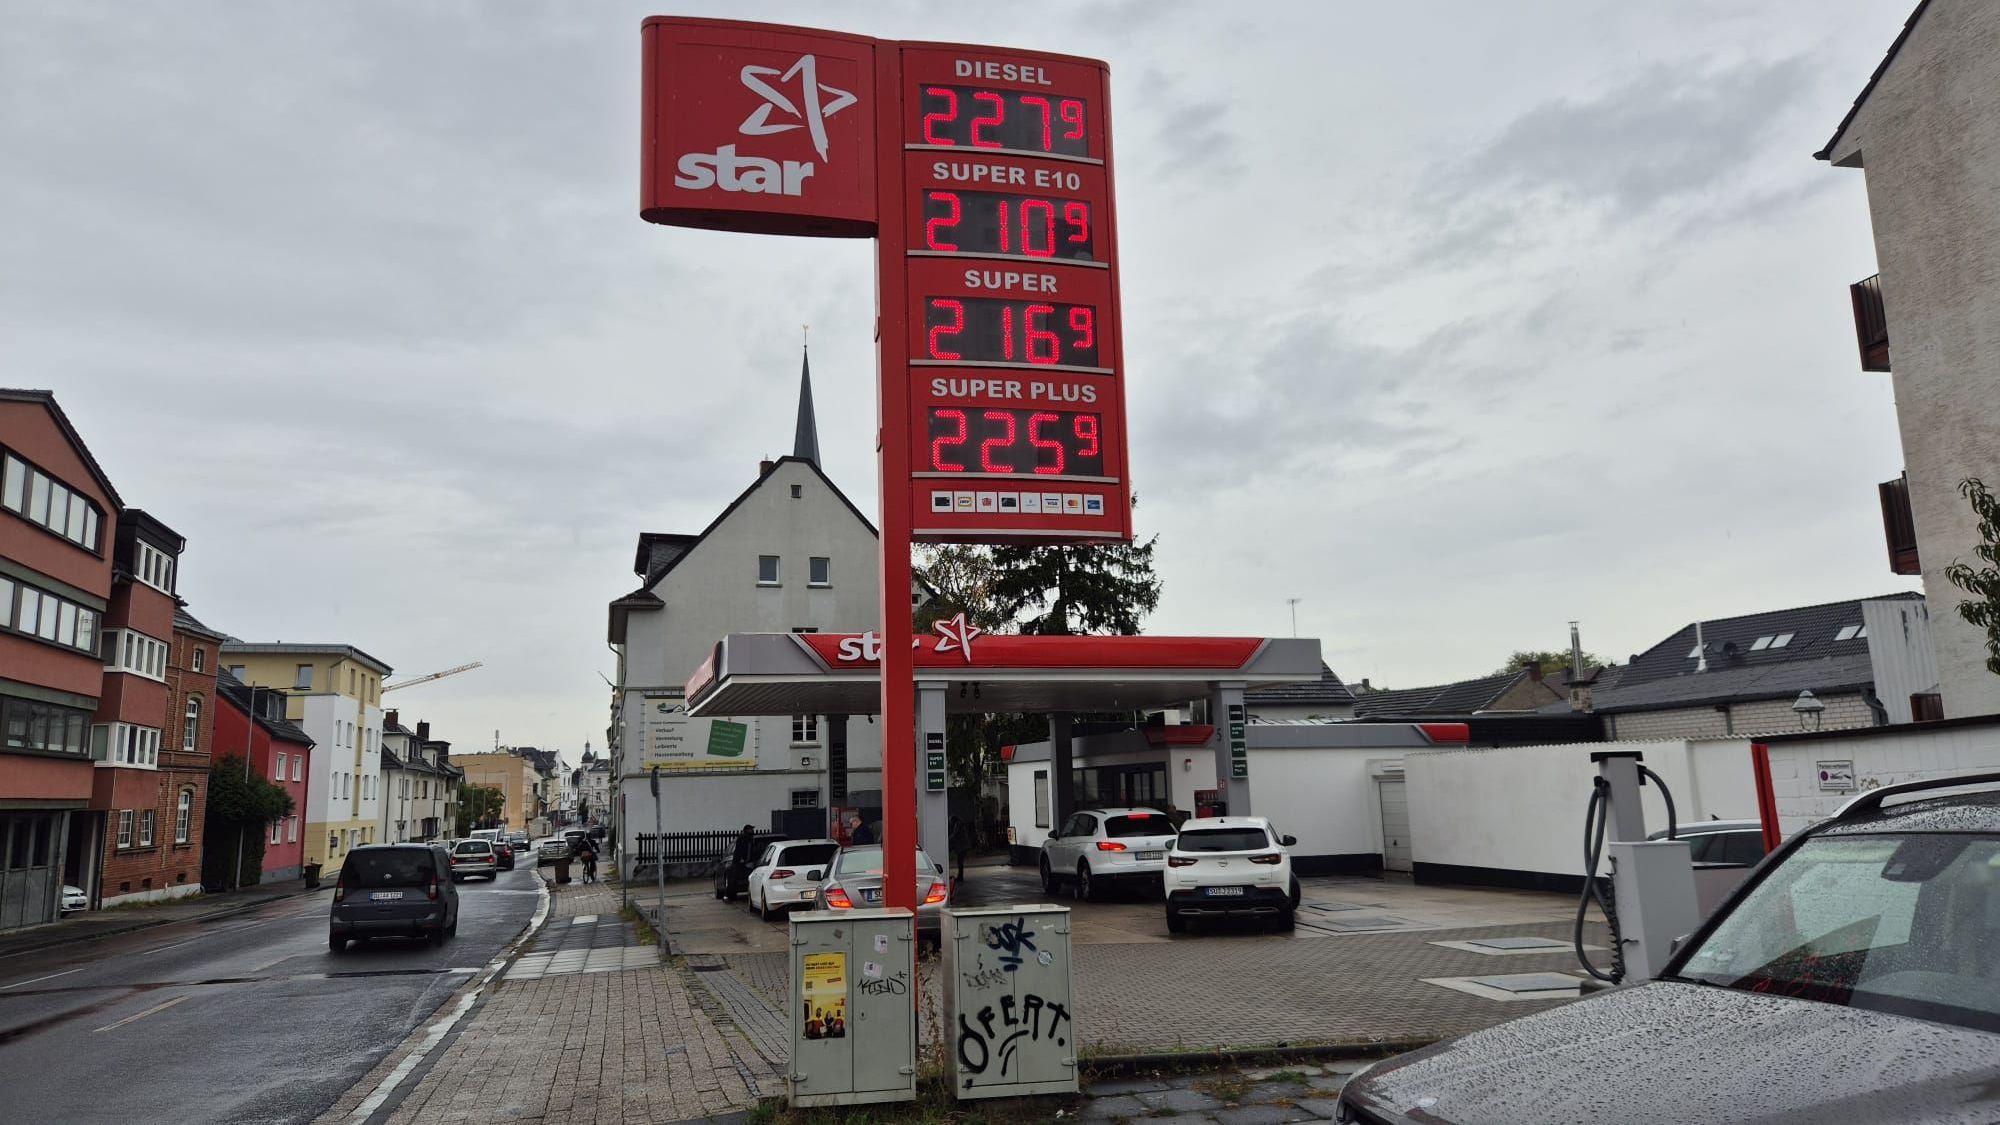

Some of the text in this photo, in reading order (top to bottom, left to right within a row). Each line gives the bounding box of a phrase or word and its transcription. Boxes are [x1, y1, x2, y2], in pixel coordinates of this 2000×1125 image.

[955, 58, 1052, 86] DIESEL
[675, 143, 815, 197] star
[932, 162, 1081, 191] SUPER E10
[964, 269, 1058, 293] SUPER
[931, 378, 1097, 403] SUPER PLUS
